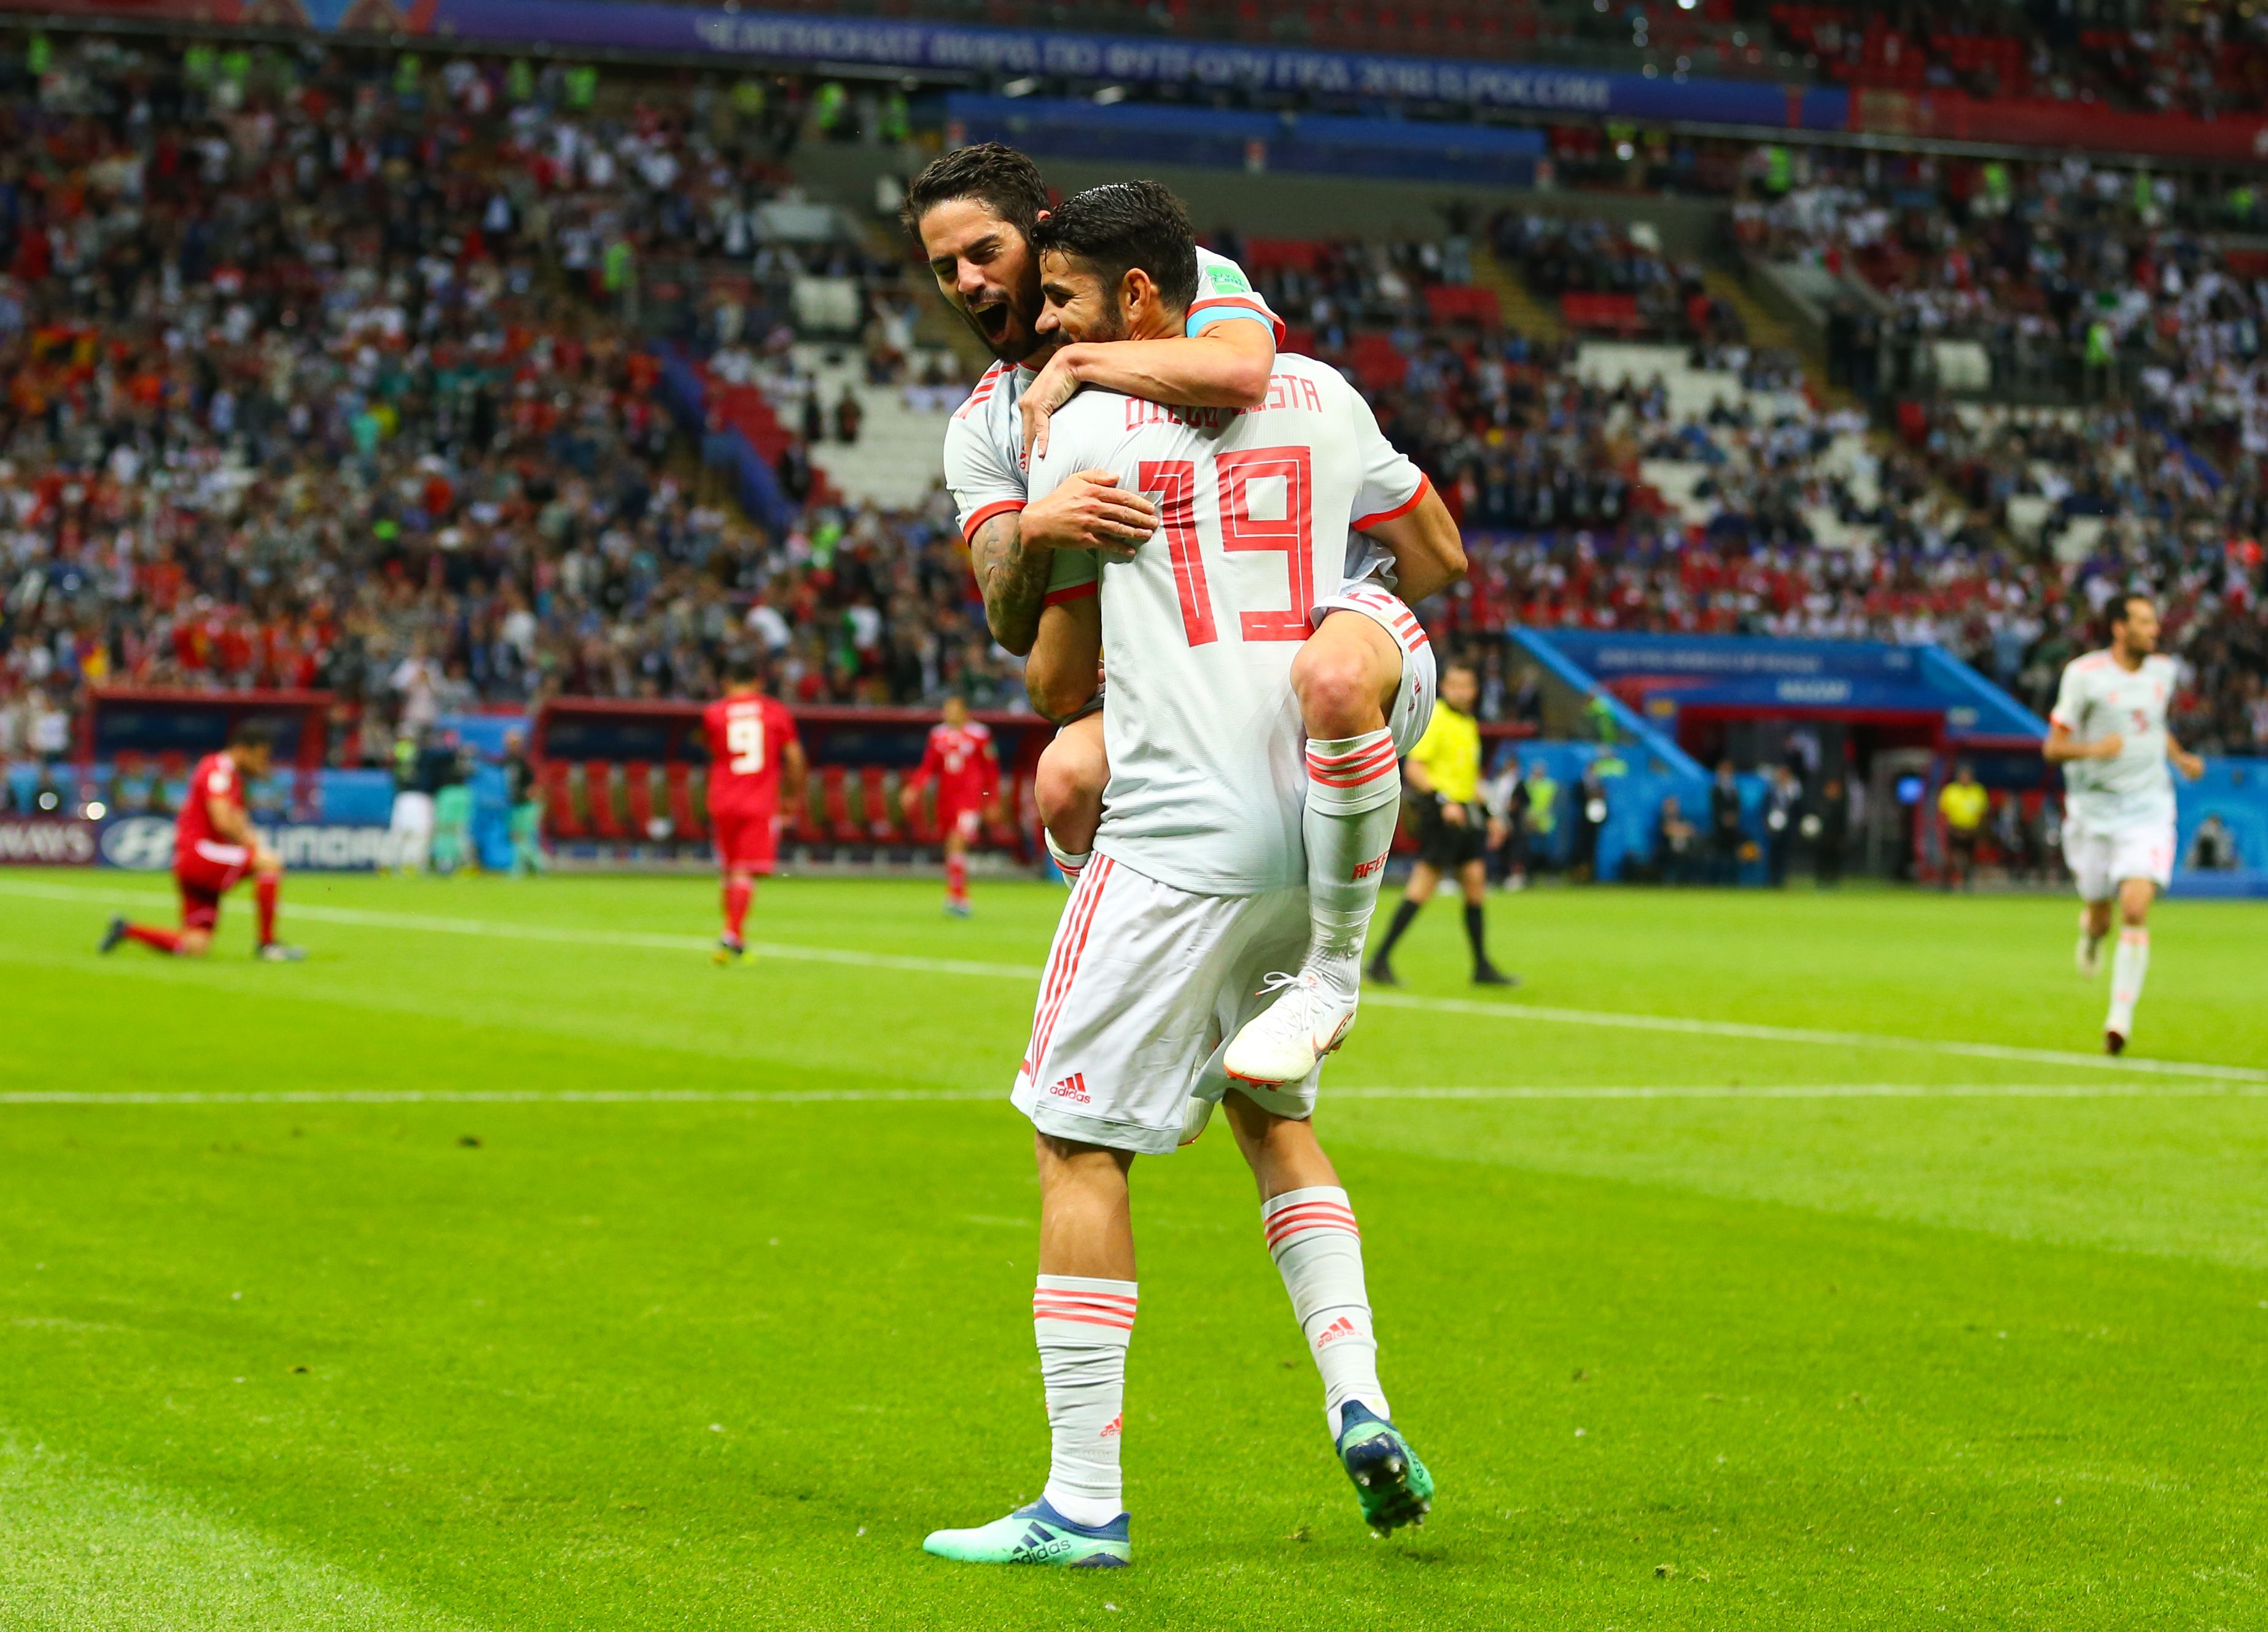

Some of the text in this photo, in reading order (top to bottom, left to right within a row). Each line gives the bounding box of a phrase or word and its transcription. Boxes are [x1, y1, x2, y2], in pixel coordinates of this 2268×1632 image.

[1139, 446, 1316, 647] 19
[727, 719, 764, 775] 9
[1050, 1086, 1091, 1104] adidas
